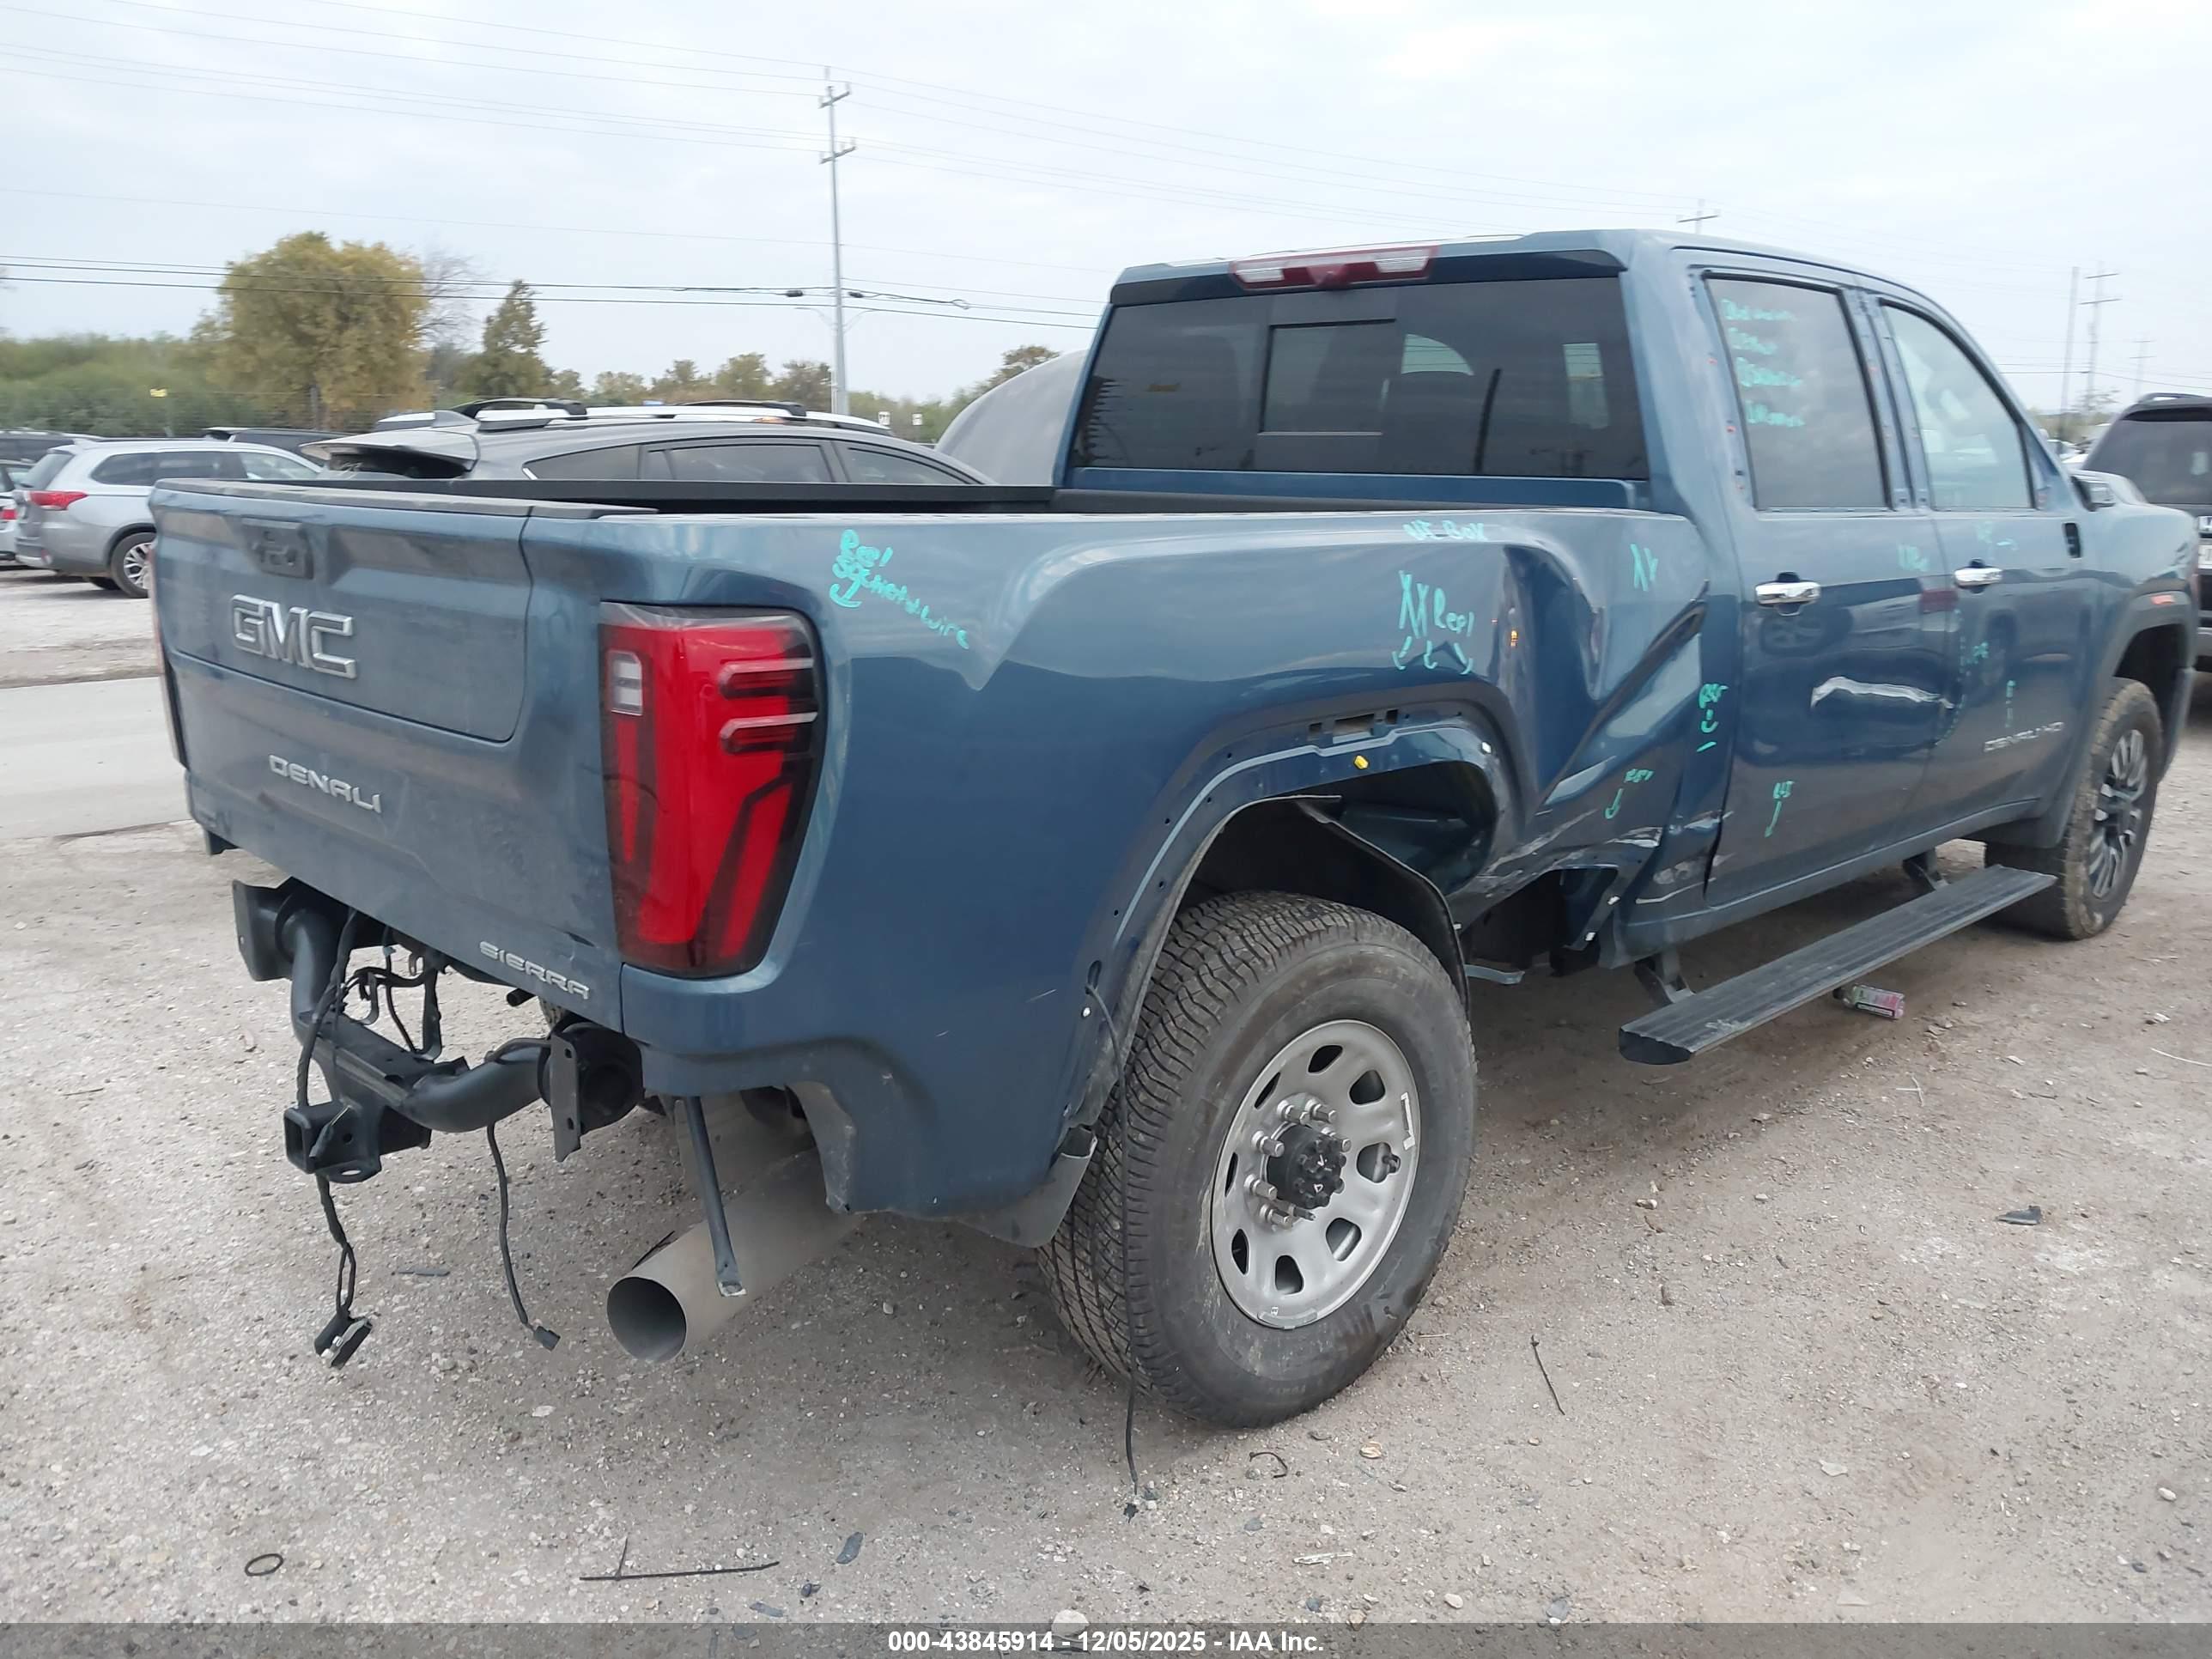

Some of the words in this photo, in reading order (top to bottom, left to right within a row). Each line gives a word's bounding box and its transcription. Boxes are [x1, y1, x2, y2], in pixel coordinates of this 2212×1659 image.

[230, 594, 357, 679] GMC
[269, 754, 382, 813] DENALI
[479, 941, 590, 1000] SIERRA
